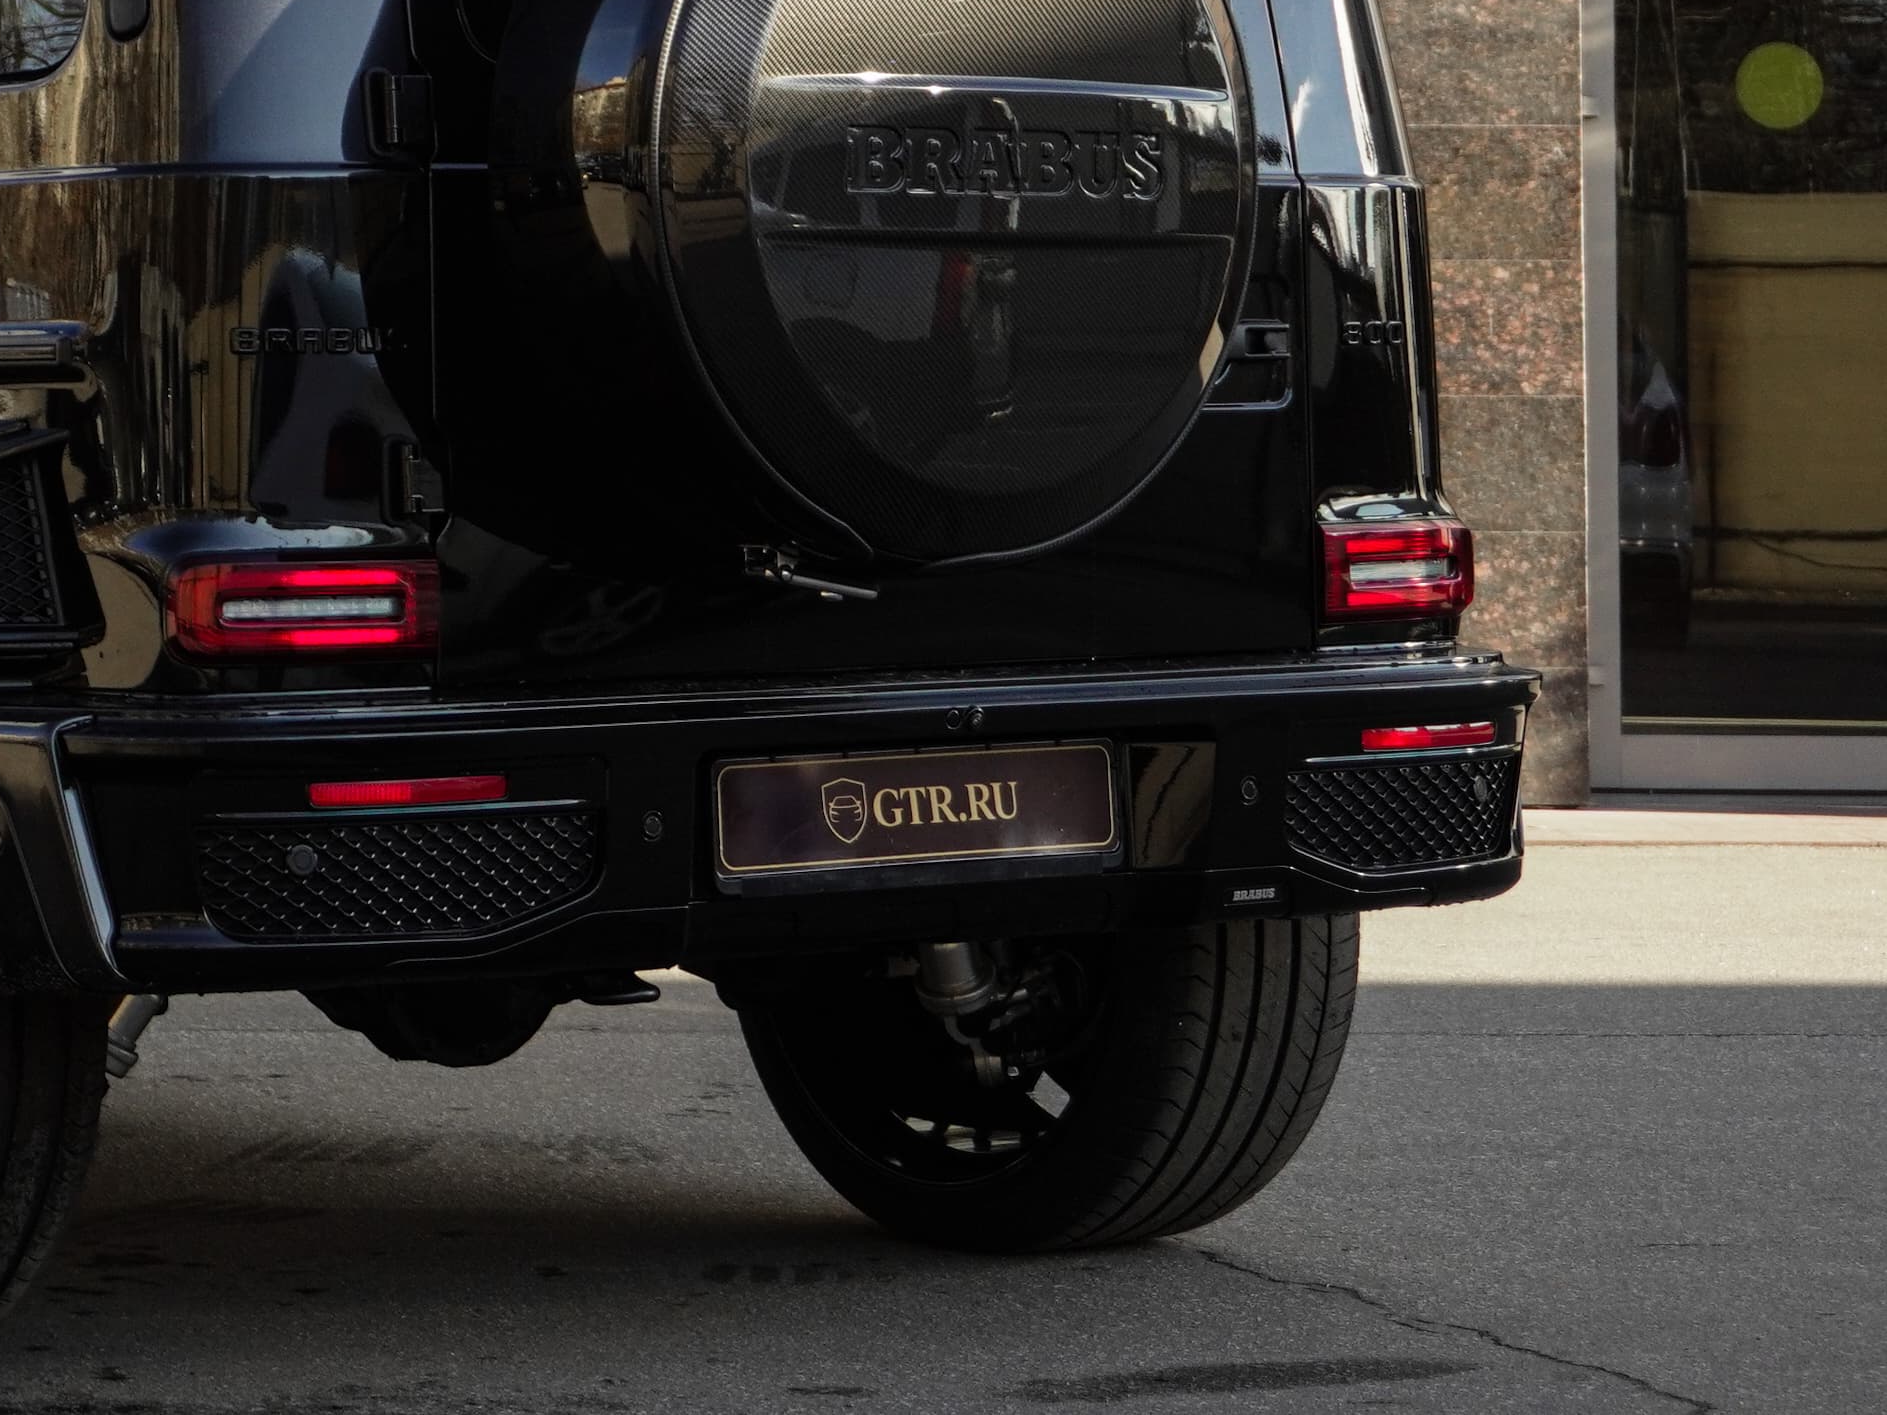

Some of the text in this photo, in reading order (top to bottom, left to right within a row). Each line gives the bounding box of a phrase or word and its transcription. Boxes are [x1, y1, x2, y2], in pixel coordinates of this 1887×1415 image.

[846, 125, 1165, 201] BRABUS
[229, 327, 408, 354] BRABU
[872, 780, 1018, 828] GTR.RU
[1232, 887, 1276, 902] BRABUS
